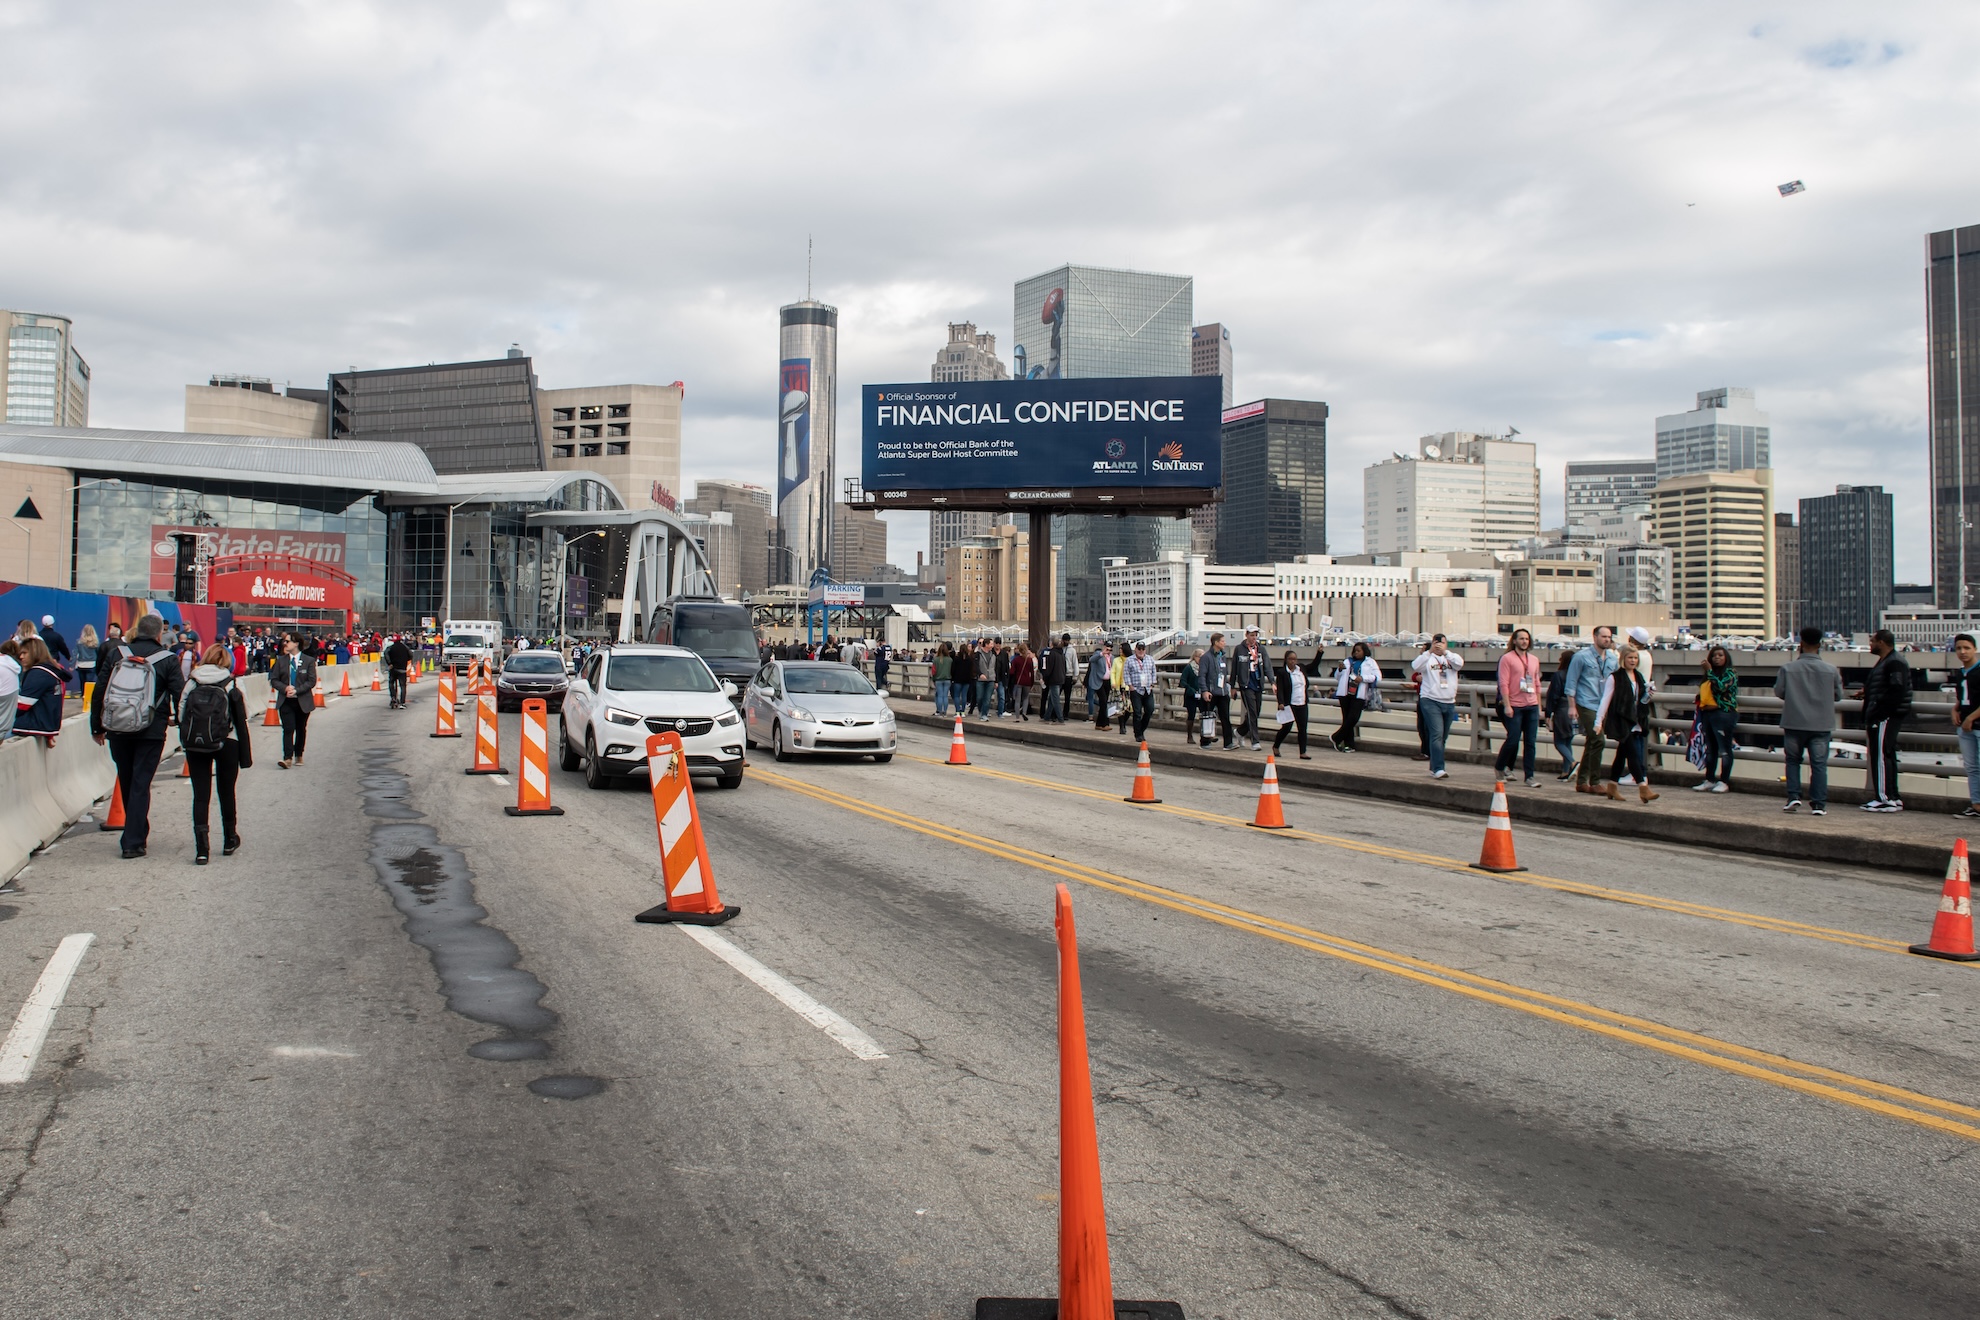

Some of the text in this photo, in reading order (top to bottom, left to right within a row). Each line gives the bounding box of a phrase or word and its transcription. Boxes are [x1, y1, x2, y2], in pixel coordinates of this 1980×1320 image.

[886, 392, 957, 402] Official Sponsor of
[878, 400, 1184, 426] FINANCIAL CONFIDENCE
[878, 440, 1014, 450] Proud to be the Official Bank of the
[878, 449, 1019, 460] Atlanta Super Bowl Host Committee
[1092, 461, 1138, 470] ATLANTA
[883, 491, 907, 499] 000345
[306, 587, 325, 602] DRIVE
[256, 641, 264, 650] 12
[573, 650, 581, 658] 12
[885, 651, 892, 660] 12
[1961, 680, 1970, 705] 1
